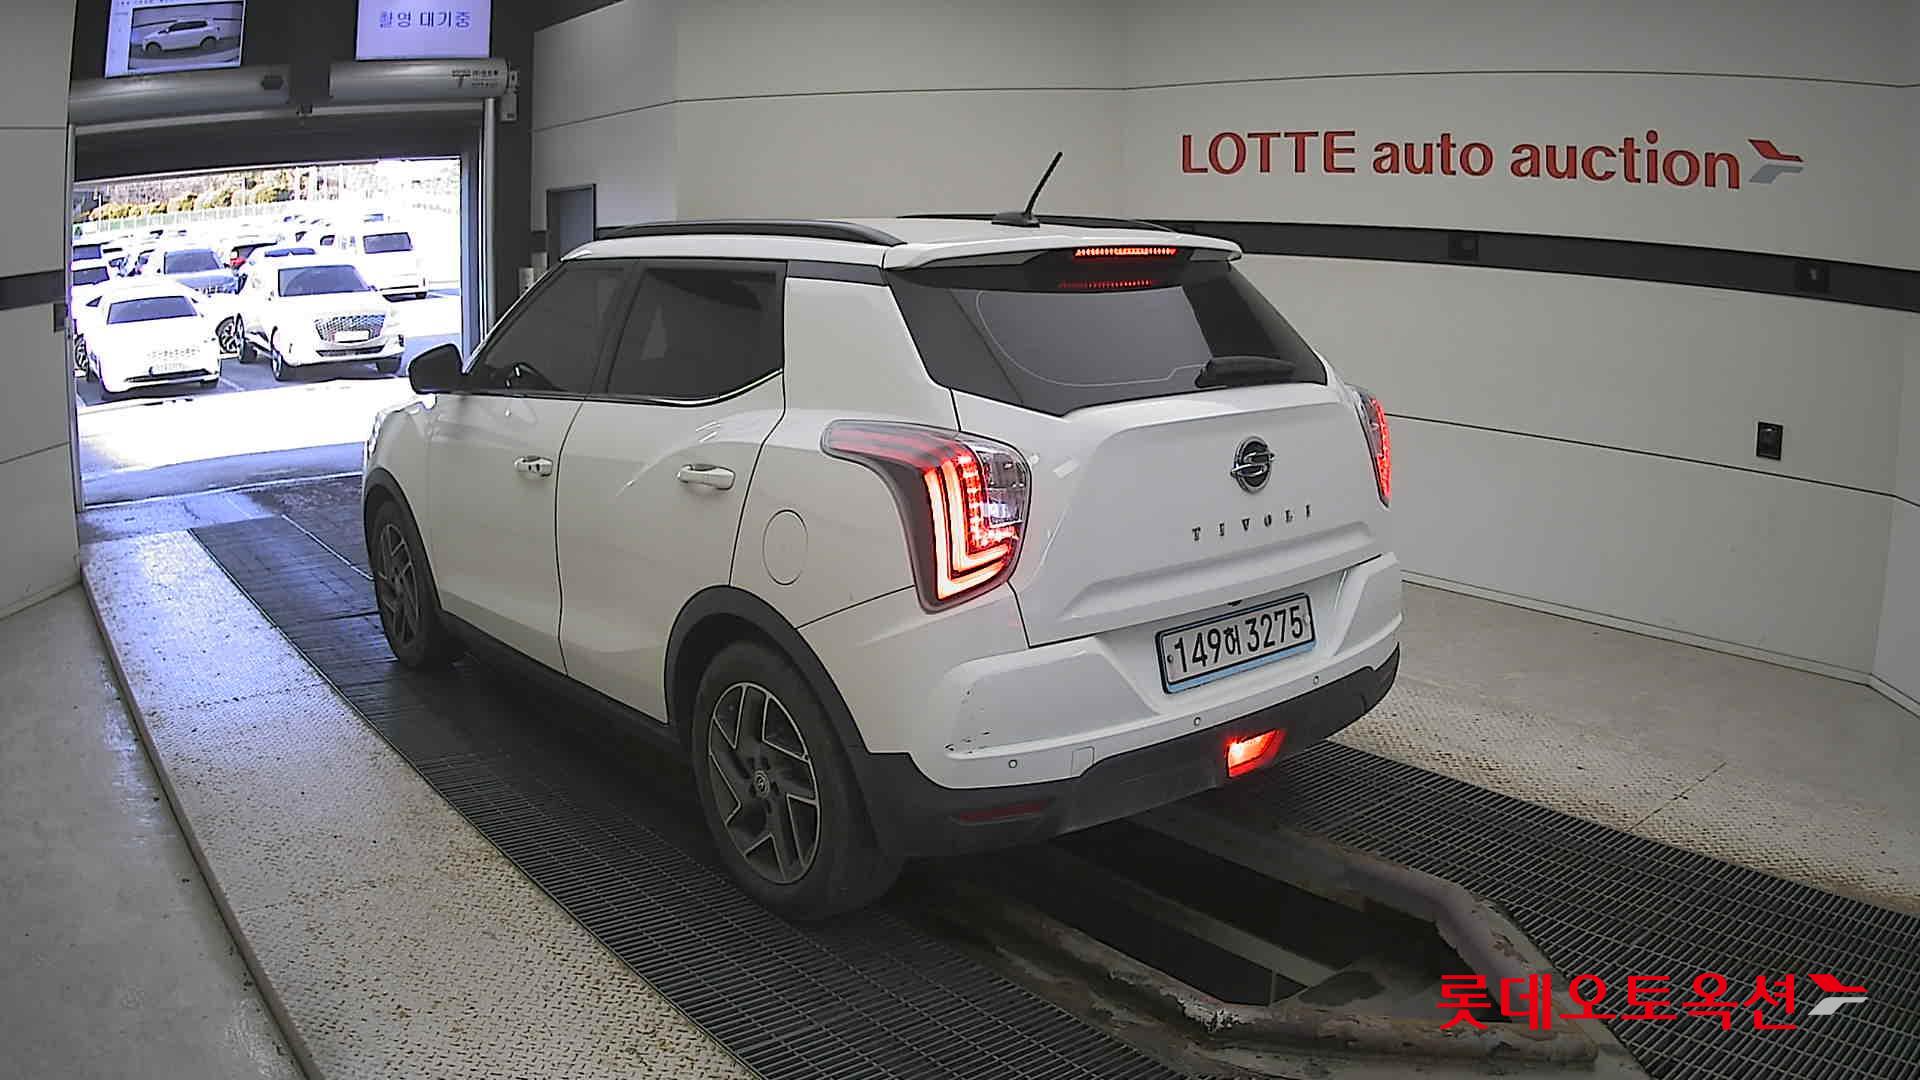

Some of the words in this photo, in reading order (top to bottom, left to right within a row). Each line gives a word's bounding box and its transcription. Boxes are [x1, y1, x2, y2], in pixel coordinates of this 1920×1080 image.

[419, 10, 471, 28] 대기중
[1181, 130, 1356, 175] LOTTE
[1372, 133, 1494, 177] auto
[1510, 130, 1741, 189] auction
[1191, 503, 1313, 542] TIVOLI
